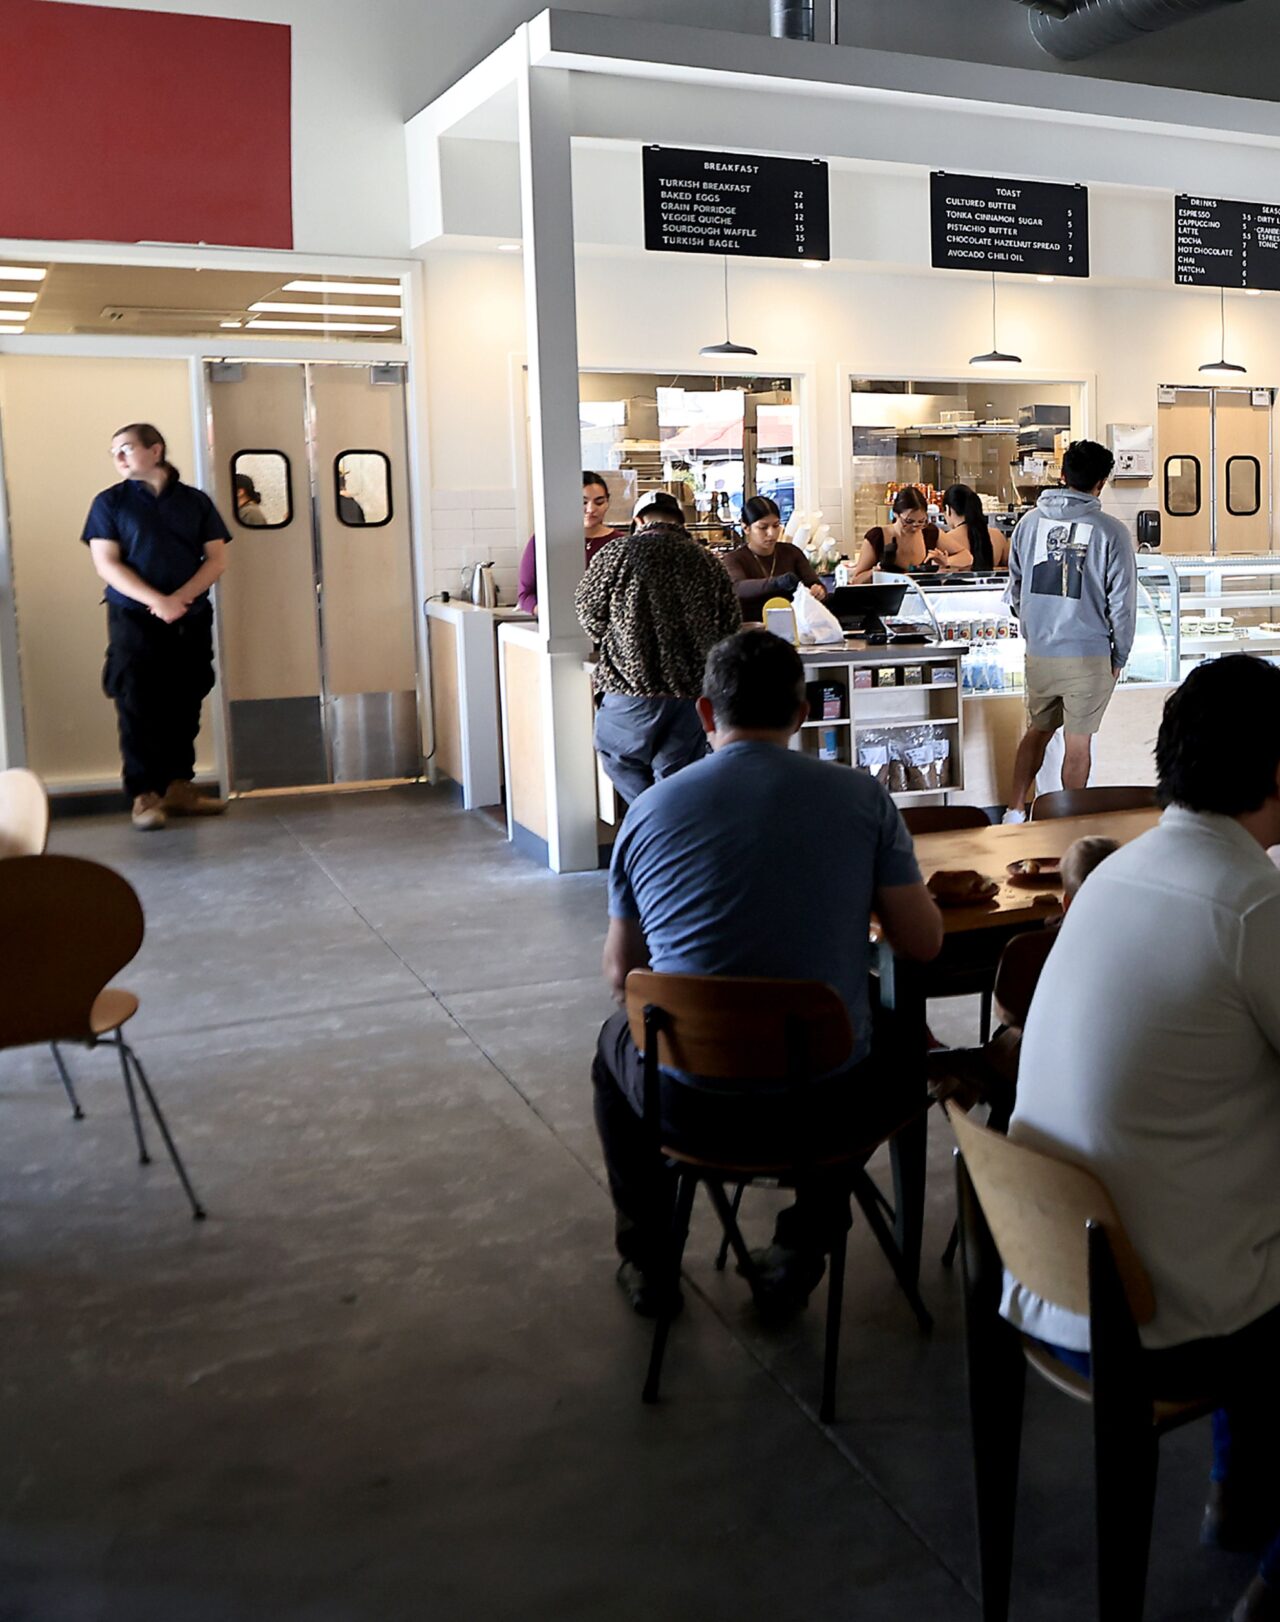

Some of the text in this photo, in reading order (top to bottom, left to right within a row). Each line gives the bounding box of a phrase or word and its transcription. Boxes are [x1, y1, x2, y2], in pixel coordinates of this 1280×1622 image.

[704, 162, 759, 174] BREAKFAST
[659, 178, 804, 199] TURKISH BREAKFAST 22
[996, 188, 1021, 198] TOAST
[661, 191, 804, 210] BAKED EGGS 14
[946, 198, 985, 208] CULTURED
[988, 202, 1016, 210] BUTTER
[1190, 199, 1217, 208] DRINKS
[661, 202, 804, 221] GRAIN PORRIDGE 12
[1179, 209, 1210, 218] ESPRESSO
[661, 213, 696, 222] VEGGIE
[698, 216, 732, 225] QUICHE
[946, 210, 972, 219] TONKA
[975, 213, 1015, 223] CINNAMON
[1018, 217, 1043, 226] SUGAR
[1178, 219, 1220, 228] CAPPUCCINO
[1257, 216, 1274, 224] DIRTY
[662, 224, 805, 242] SOURDOUGH WAFFLE 15
[947, 223, 986, 233] PISTACHIO
[989, 227, 1017, 235] BUTTER
[1178, 227, 1199, 235] LATTE
[662, 236, 704, 246] TURKISH
[709, 239, 740, 248] BAGEL
[947, 235, 991, 246] CHOCOLATE
[994, 239, 1031, 248] HAZELNUT
[1033, 242, 1061, 250] SPREAD
[1178, 237, 1202, 245] MOCHA
[1258, 241, 1278, 249] TONIC
[948, 250, 984, 259] AVOCADO
[988, 252, 1009, 260] CHILI
[1010, 254, 1024, 262] OIL
[1194, 247, 1233, 256] CHOCOLATE
[1178, 256, 1195, 264] CHAI
[1178, 266, 1205, 274] MATCHA
